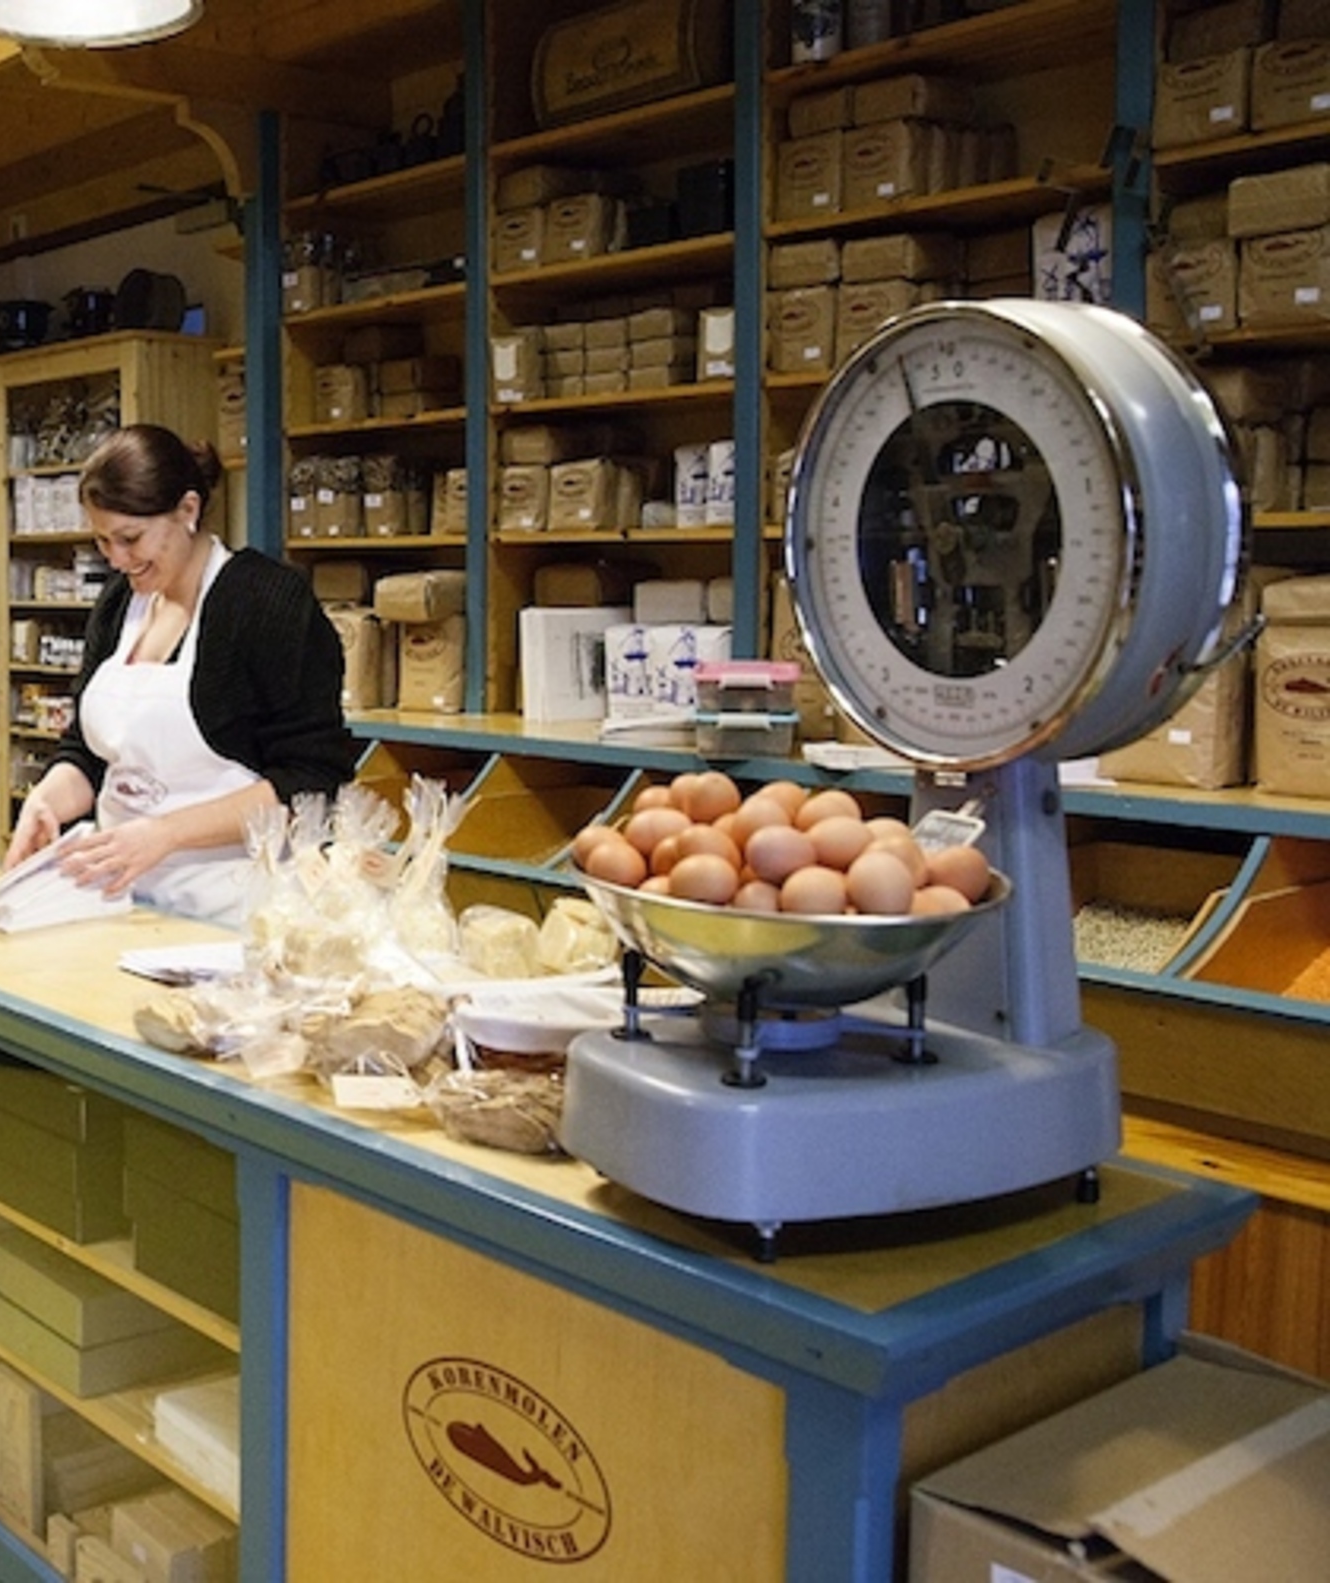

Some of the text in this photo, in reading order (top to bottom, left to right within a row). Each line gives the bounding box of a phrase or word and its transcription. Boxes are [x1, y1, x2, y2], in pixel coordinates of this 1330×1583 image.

[1023, 675, 1034, 693] 2
[426, 1367, 584, 1463] KORENMOLEN
[428, 1456, 580, 1556] DE WALVISCH
